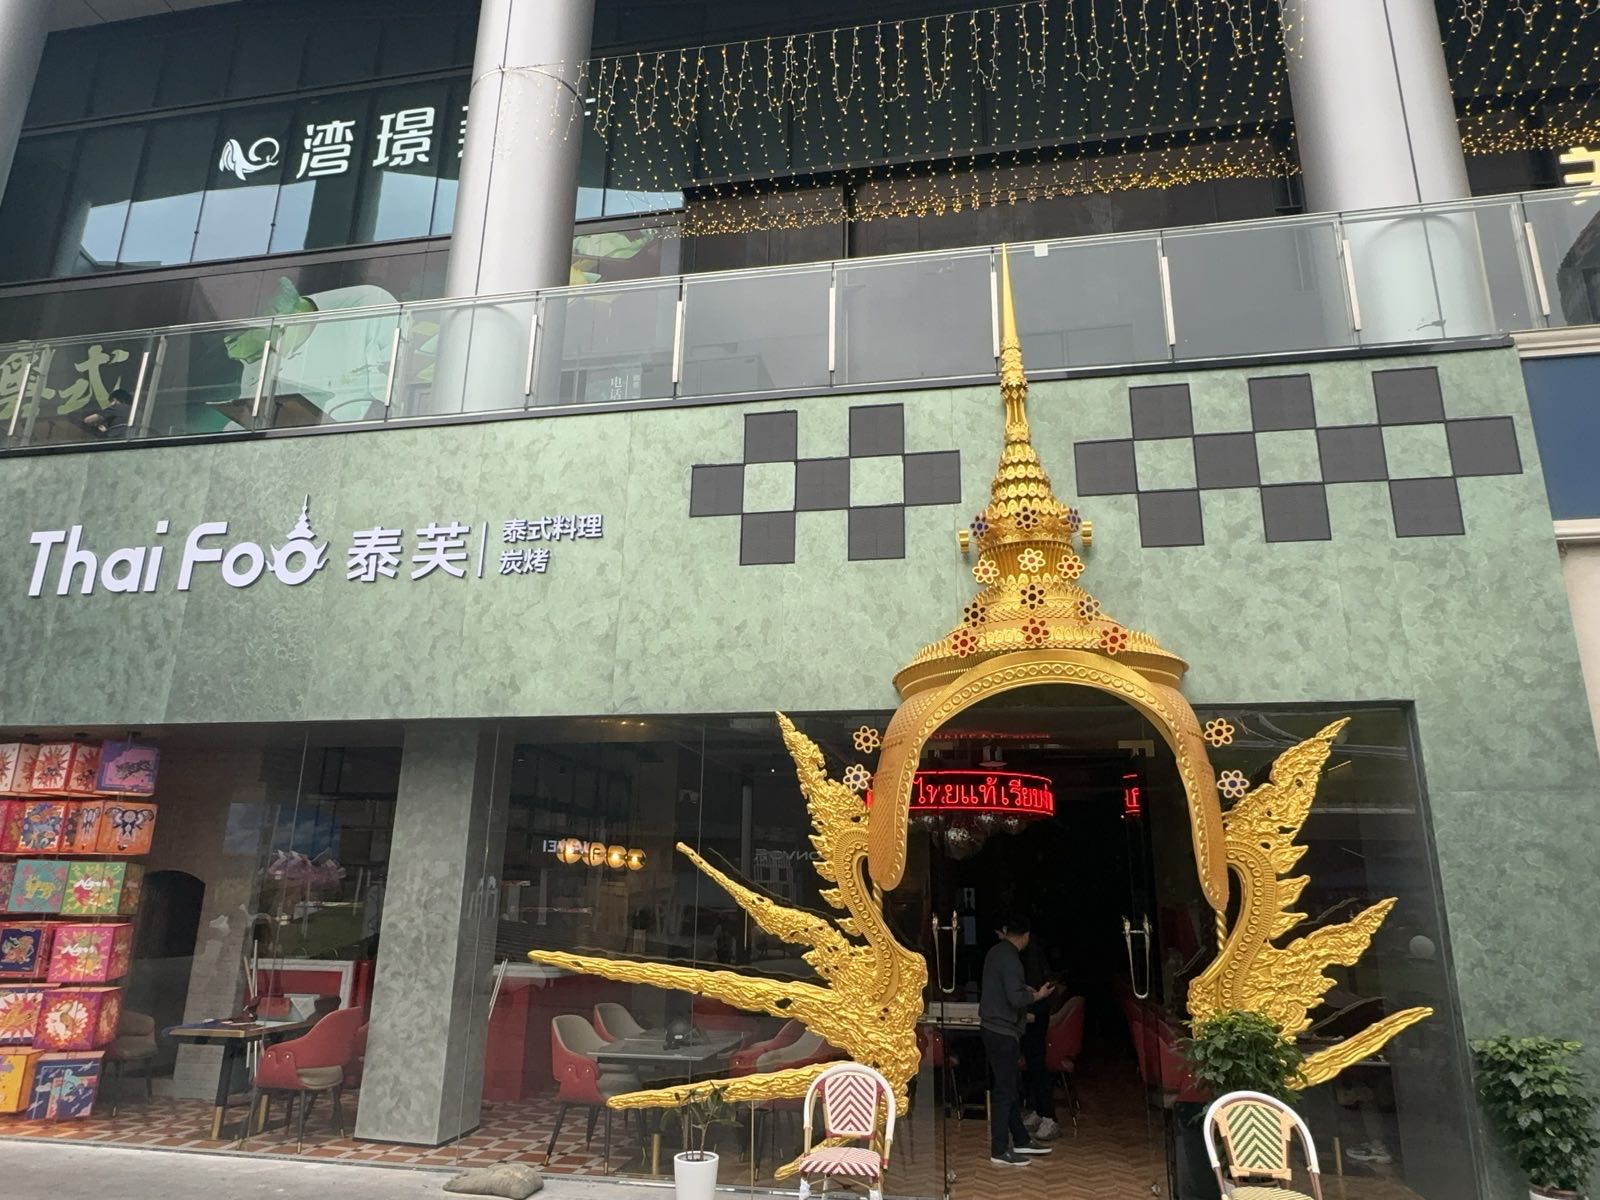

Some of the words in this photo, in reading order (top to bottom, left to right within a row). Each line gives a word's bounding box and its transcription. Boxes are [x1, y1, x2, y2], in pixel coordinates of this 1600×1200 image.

[296, 104, 469, 180] 湾璟
[28, 519, 170, 597] Thai
[346, 521, 471, 583] 泰芙
[502, 513, 604, 543] 泰式料理
[498, 547, 551, 575] 炭烤
